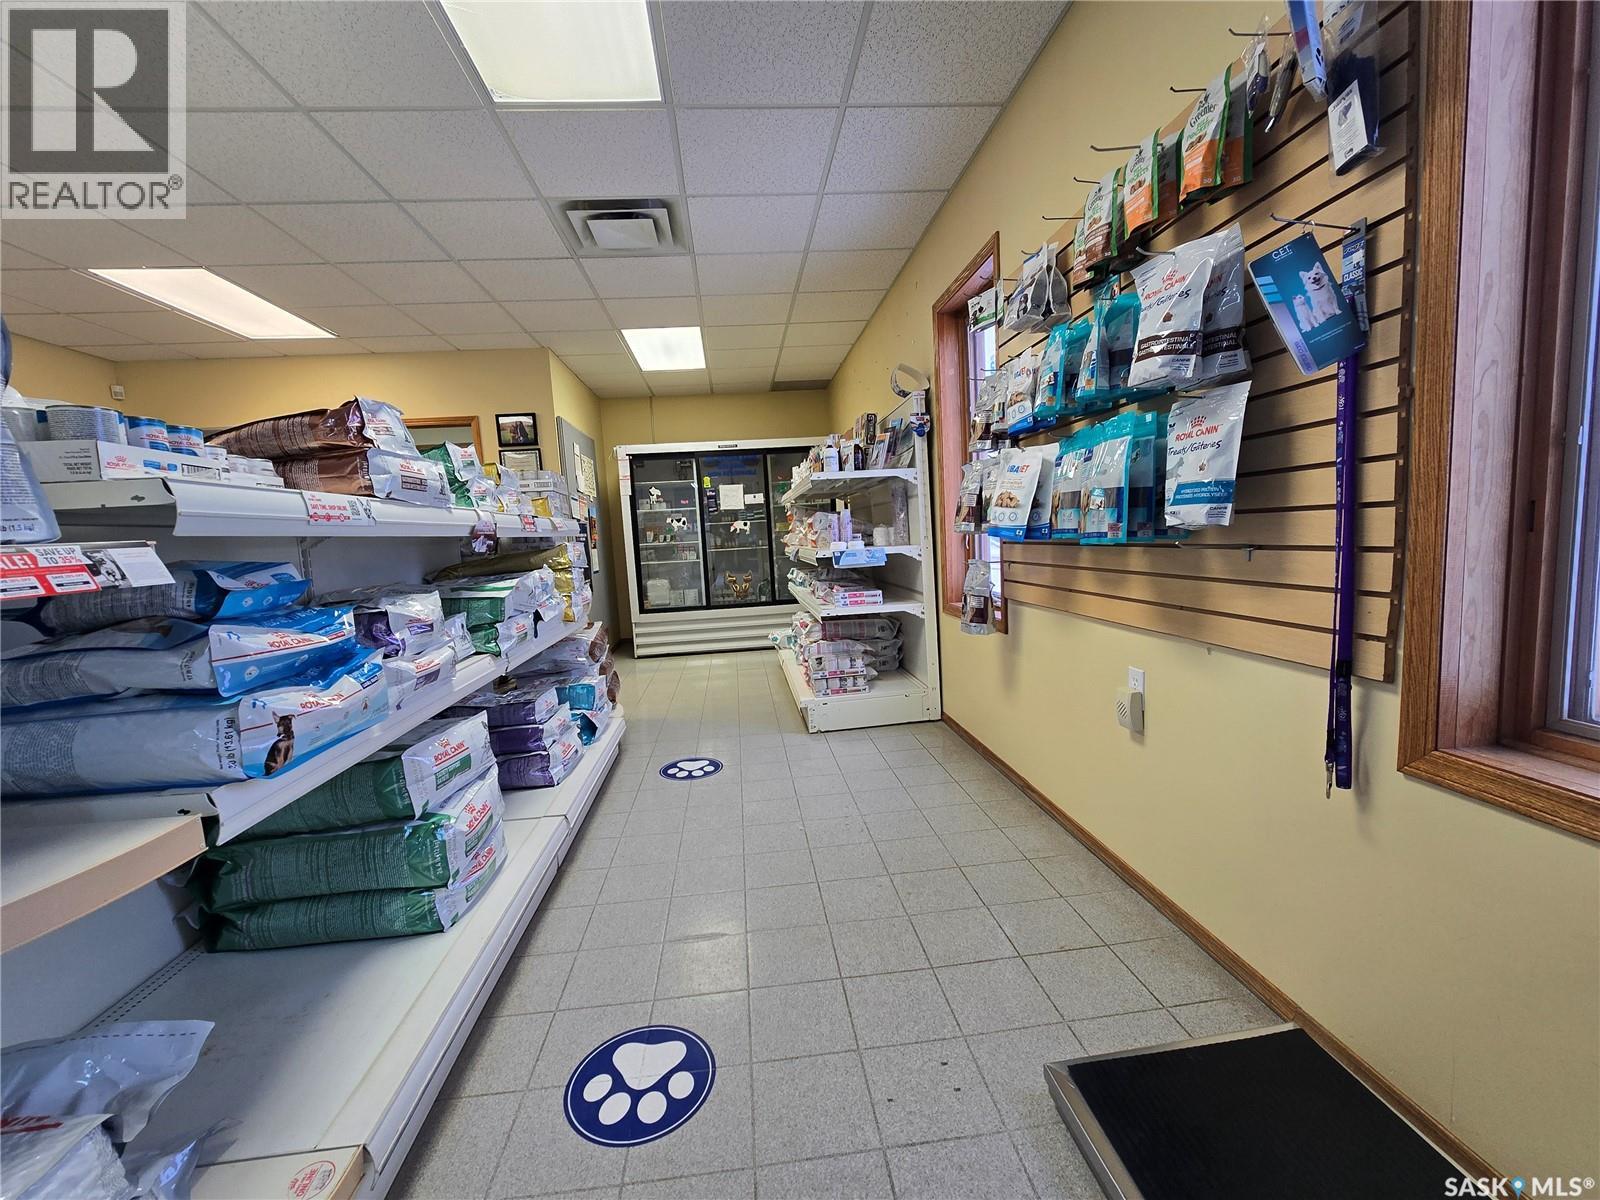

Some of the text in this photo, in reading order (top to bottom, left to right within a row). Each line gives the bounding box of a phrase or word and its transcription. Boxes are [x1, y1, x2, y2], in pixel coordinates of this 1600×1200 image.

[1175, 424, 1220, 442] ROYAL CANIN
[34, 546, 77, 557] SAVE UP
[43, 556, 58, 565] TO
[224, 717, 236, 729] kg)
[433, 749, 451, 763] ROYAL
